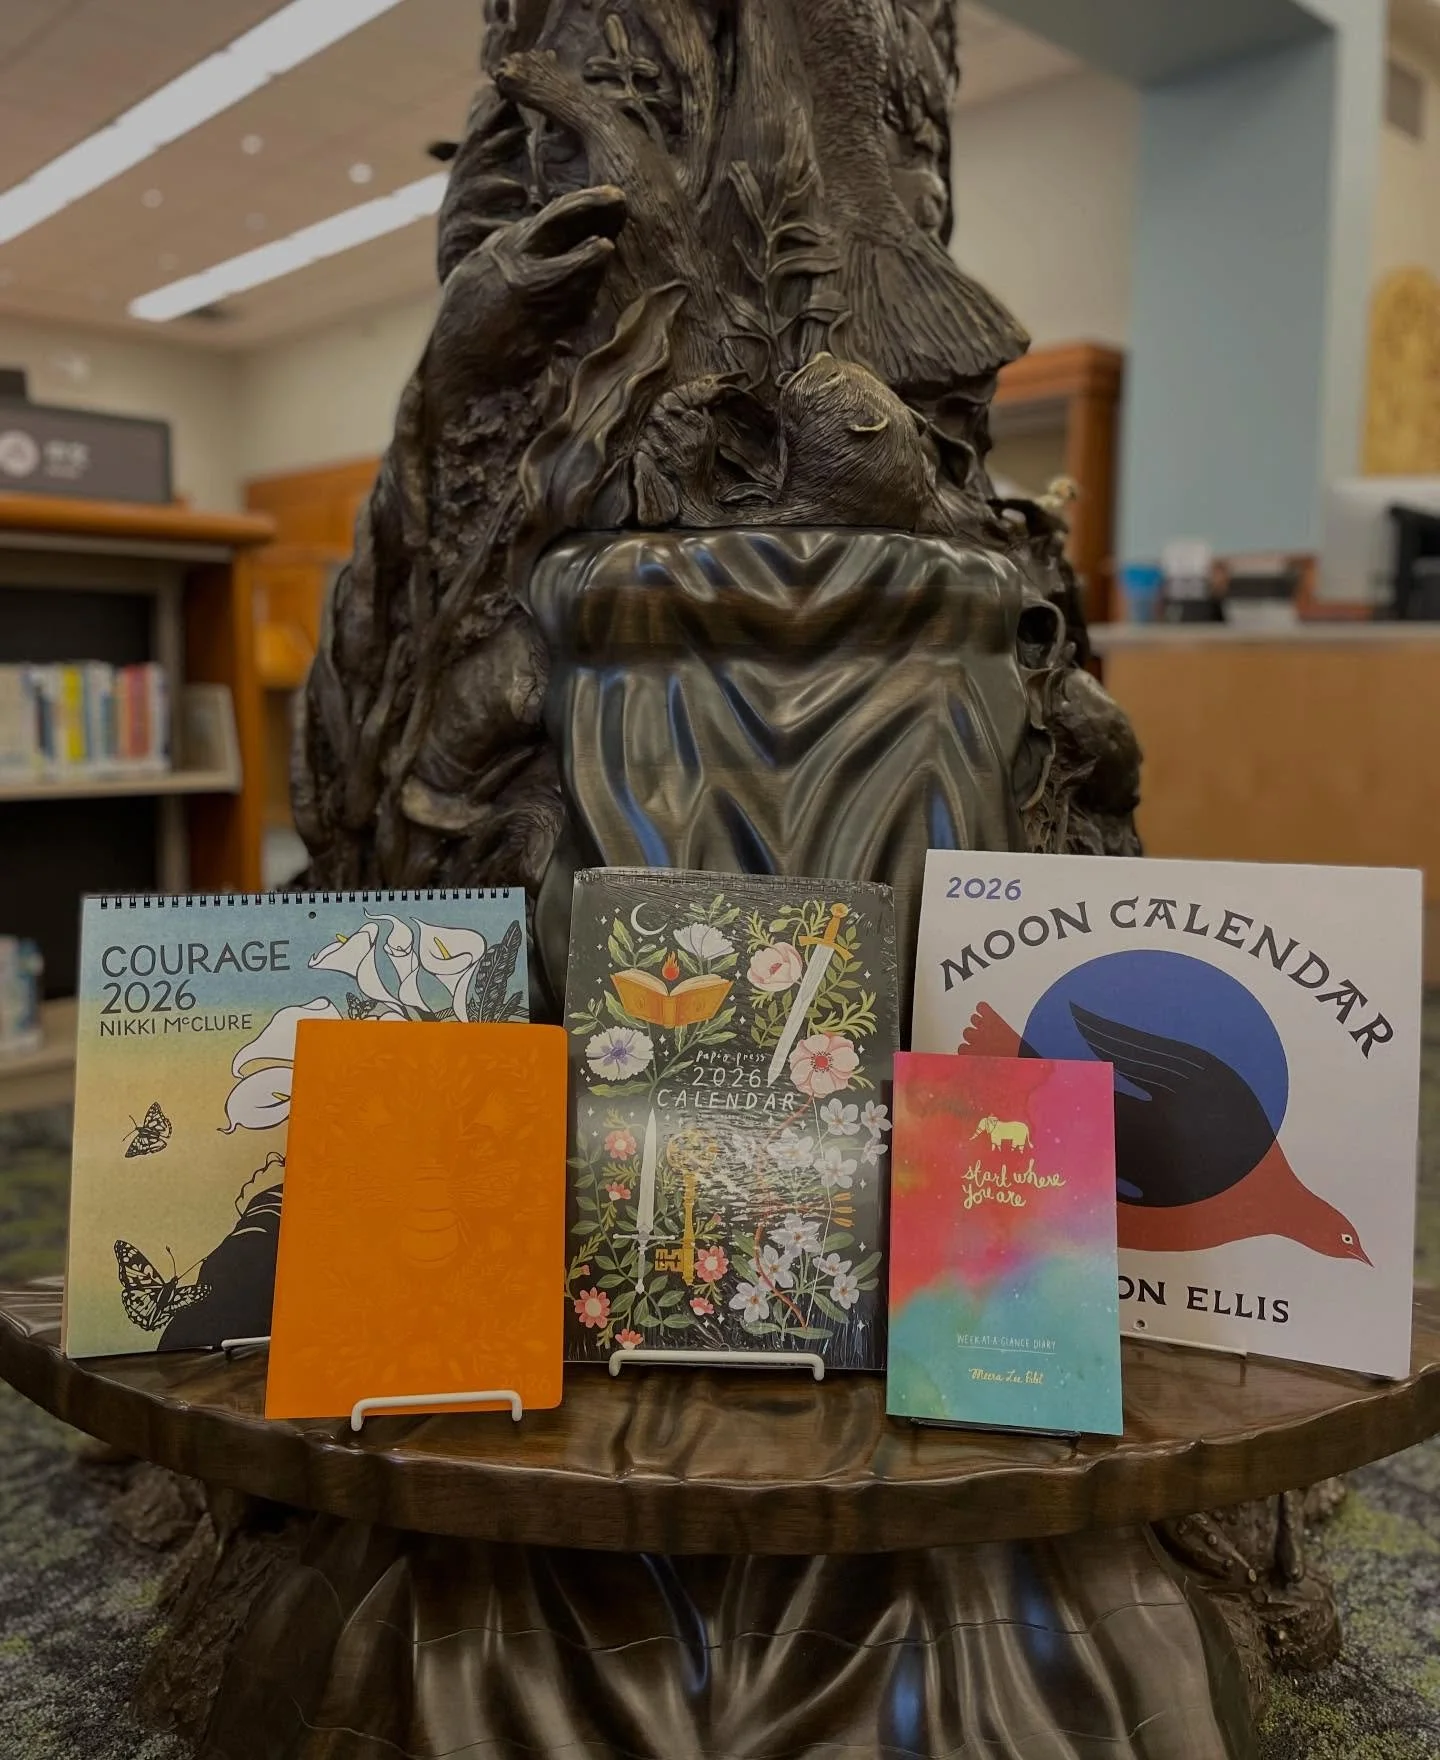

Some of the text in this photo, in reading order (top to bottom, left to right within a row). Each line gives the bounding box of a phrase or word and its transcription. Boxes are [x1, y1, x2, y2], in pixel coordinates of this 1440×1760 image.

[946, 877, 1022, 900] 2026
[101, 940, 290, 977] COURAGE
[939, 896, 1394, 1059] MOON CALENDAR
[100, 979, 197, 1014] 2026
[100, 1018, 155, 1036] NIKKI
[736, 1051, 766, 1066] press
[692, 1066, 761, 1088] 2026
[657, 1089, 795, 1111] CALENDAR
[961, 1158, 1066, 1189] start where
[961, 1183, 1026, 1210] you are
[1186, 1286, 1290, 1324] ELLIS
